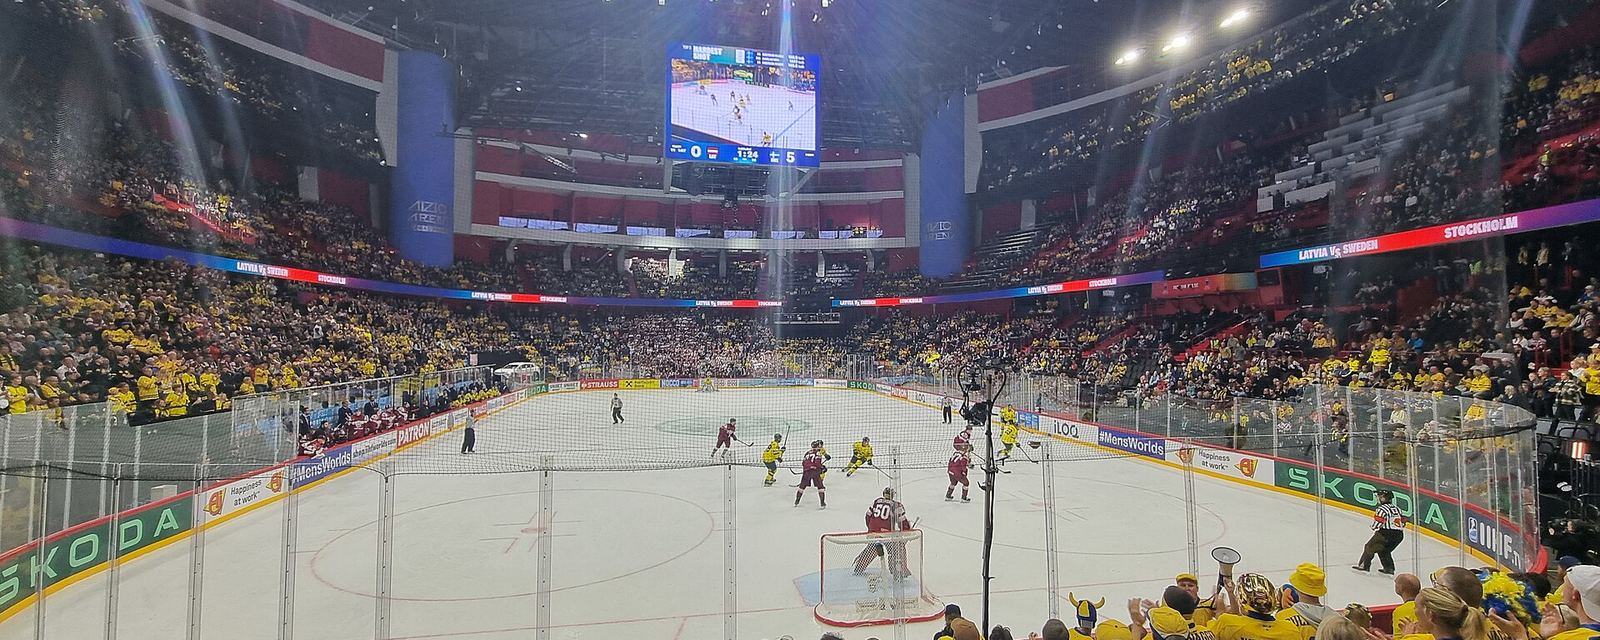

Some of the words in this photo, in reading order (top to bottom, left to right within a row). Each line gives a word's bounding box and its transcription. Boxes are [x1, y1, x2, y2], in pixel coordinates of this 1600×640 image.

[690, 145, 702, 158] 0
[737, 150, 759, 158] 1:24
[786, 151, 795, 163] 5
[1444, 215, 1518, 239] STOCKHOLM
[1298, 247, 1328, 260] LATVIA
[1343, 239, 1378, 254] SWEDEN
[236, 261, 258, 273] LATVIA
[267, 266, 289, 277] SWEDEN
[398, 421, 430, 446] PATRON
[1053, 419, 1079, 439] iLOQ
[1100, 431, 1164, 455] #MensWorlds
[1198, 449, 1230, 462] Happiness
[230, 480, 262, 496] Happiness
[234, 497, 241, 506] at
[873, 503, 890, 520] 50
